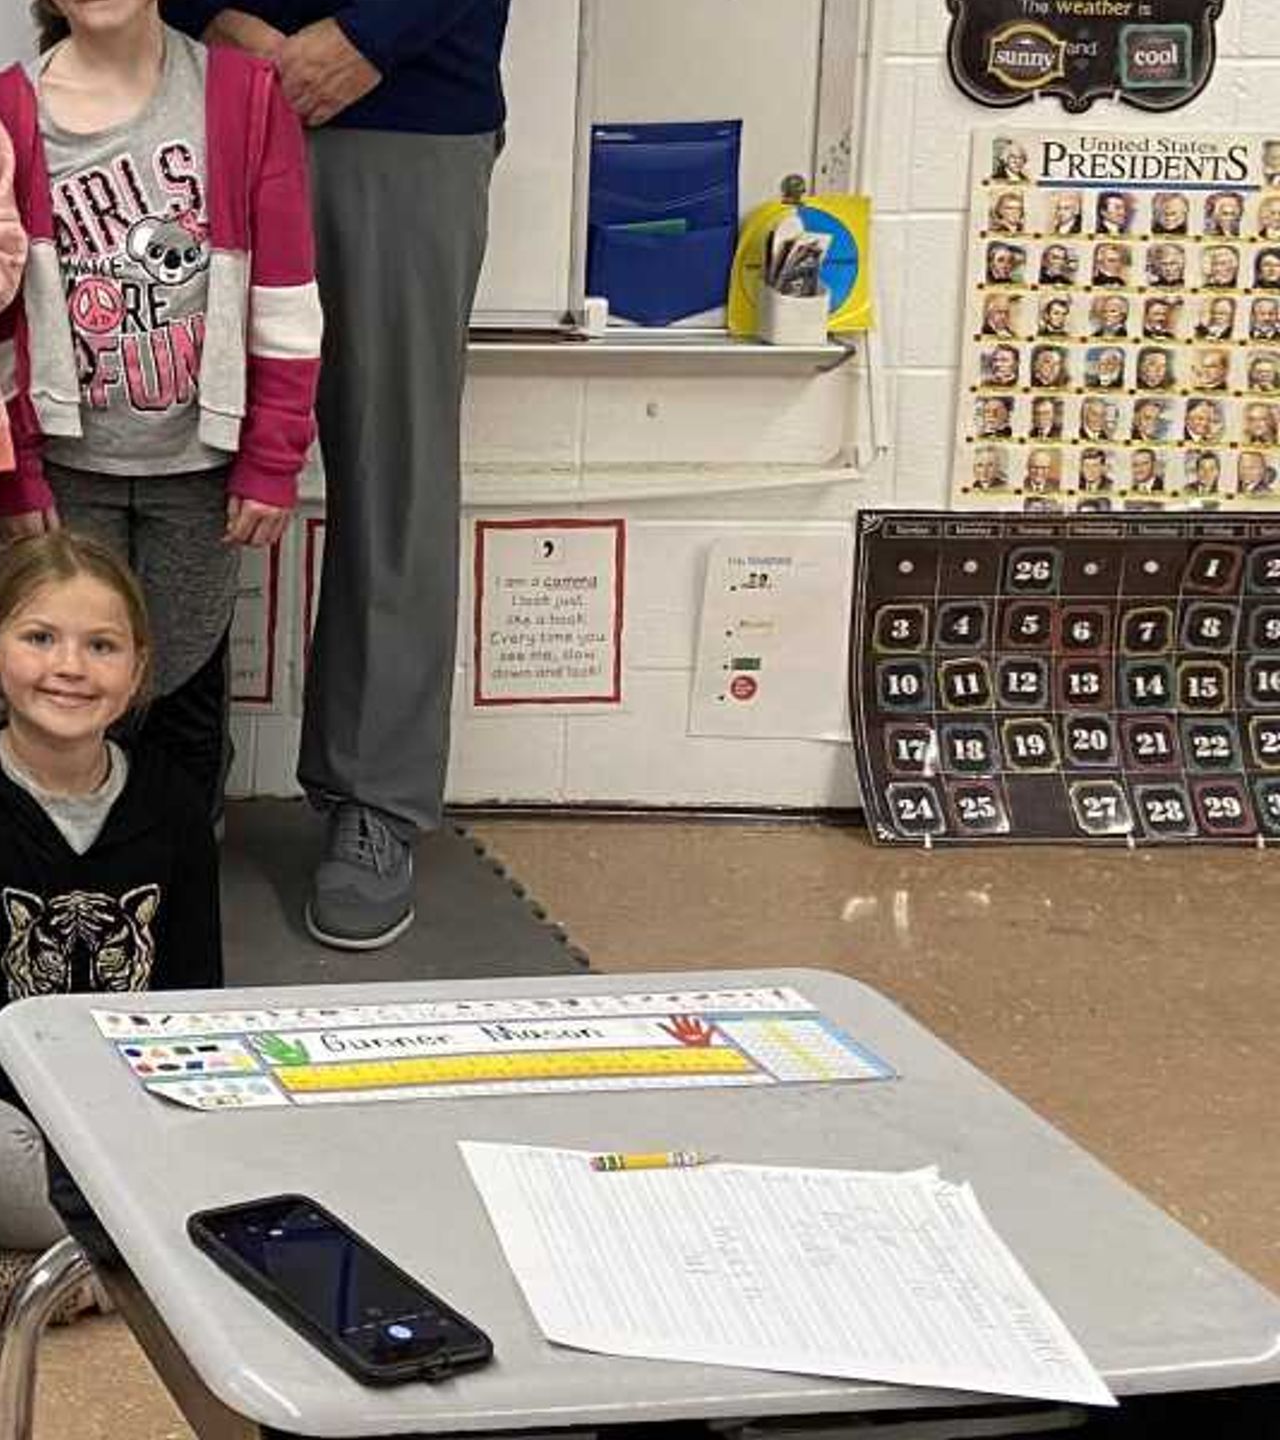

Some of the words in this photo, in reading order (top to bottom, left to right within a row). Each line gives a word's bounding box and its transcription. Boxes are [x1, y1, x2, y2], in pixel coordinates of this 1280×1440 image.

[995, 48, 1056, 71] sunny
[1066, 41, 1097, 57] and
[1134, 43, 1179, 66] cool
[1040, 139, 1249, 182] PRESIDENTS
[1079, 137, 1150, 154] United
[1155, 137, 1217, 155] States
[88, 314, 206, 411] FUN
[1014, 561, 1051, 580] 26
[887, 674, 918, 695] 10
[952, 674, 980, 695] 11
[1007, 671, 1039, 692] 12
[1068, 673, 1100, 693] 13
[1134, 676, 1165, 697] 14
[1187, 677, 1218, 698] 15
[953, 738, 985, 761] 18
[1014, 734, 1047, 756] 19
[1072, 728, 1108, 751] 20
[1135, 732, 1169, 755] 21
[1193, 736, 1230, 758] 22
[897, 797, 934, 821] 24
[959, 796, 997, 819] 25
[1082, 796, 1118, 818] 27
[1145, 799, 1184, 822] 28
[1202, 796, 1242, 819] 29
[320, 1033, 454, 1054] Gunner
[480, 1023, 605, 1043] Mason
